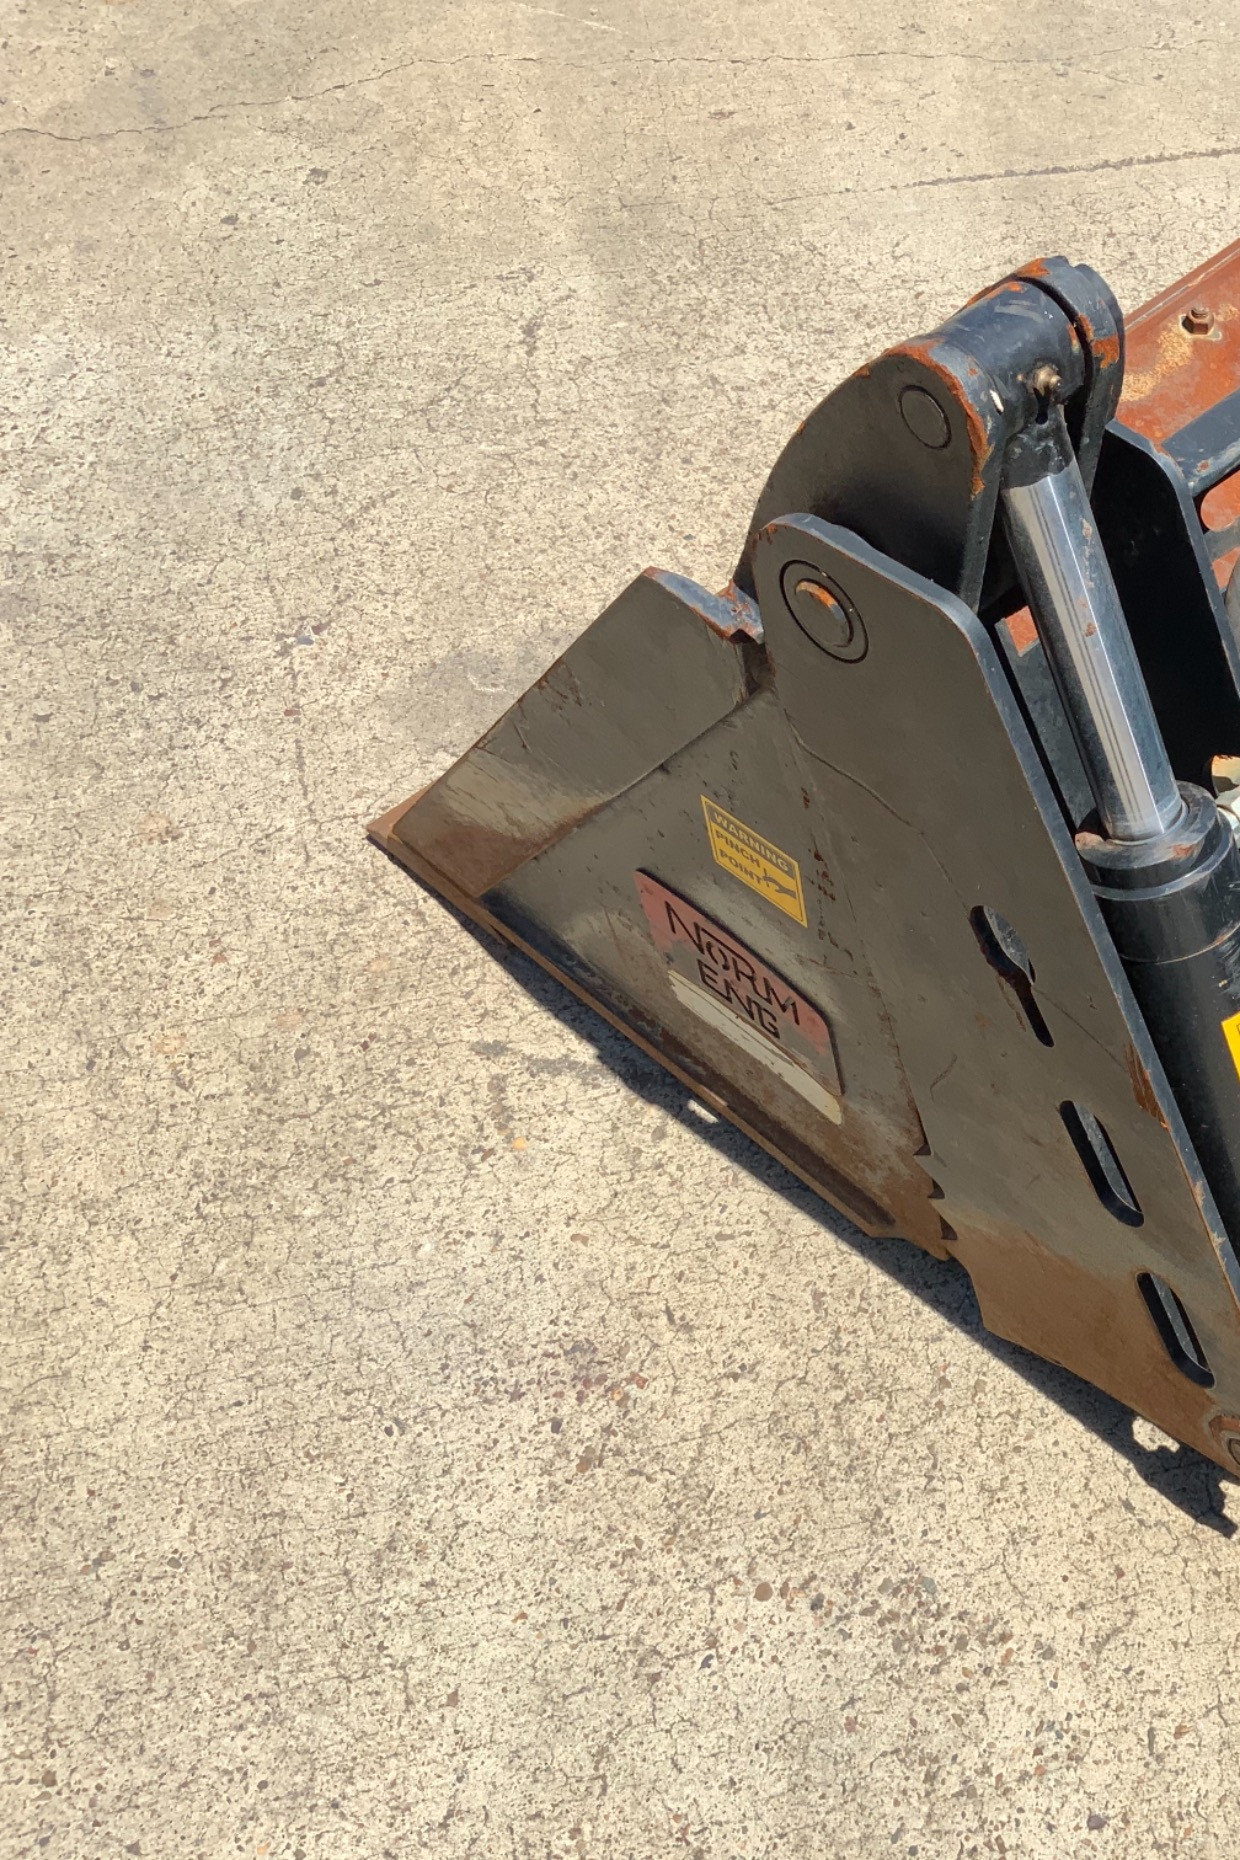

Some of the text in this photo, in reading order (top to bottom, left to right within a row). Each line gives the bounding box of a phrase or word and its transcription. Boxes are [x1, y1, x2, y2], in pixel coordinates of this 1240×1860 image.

[714, 812, 788, 871] WARNING
[715, 830, 761, 868] PINCH
[719, 848, 762, 884] POINT
[665, 901, 800, 1025] NORM
[698, 959, 780, 1039] ENG
